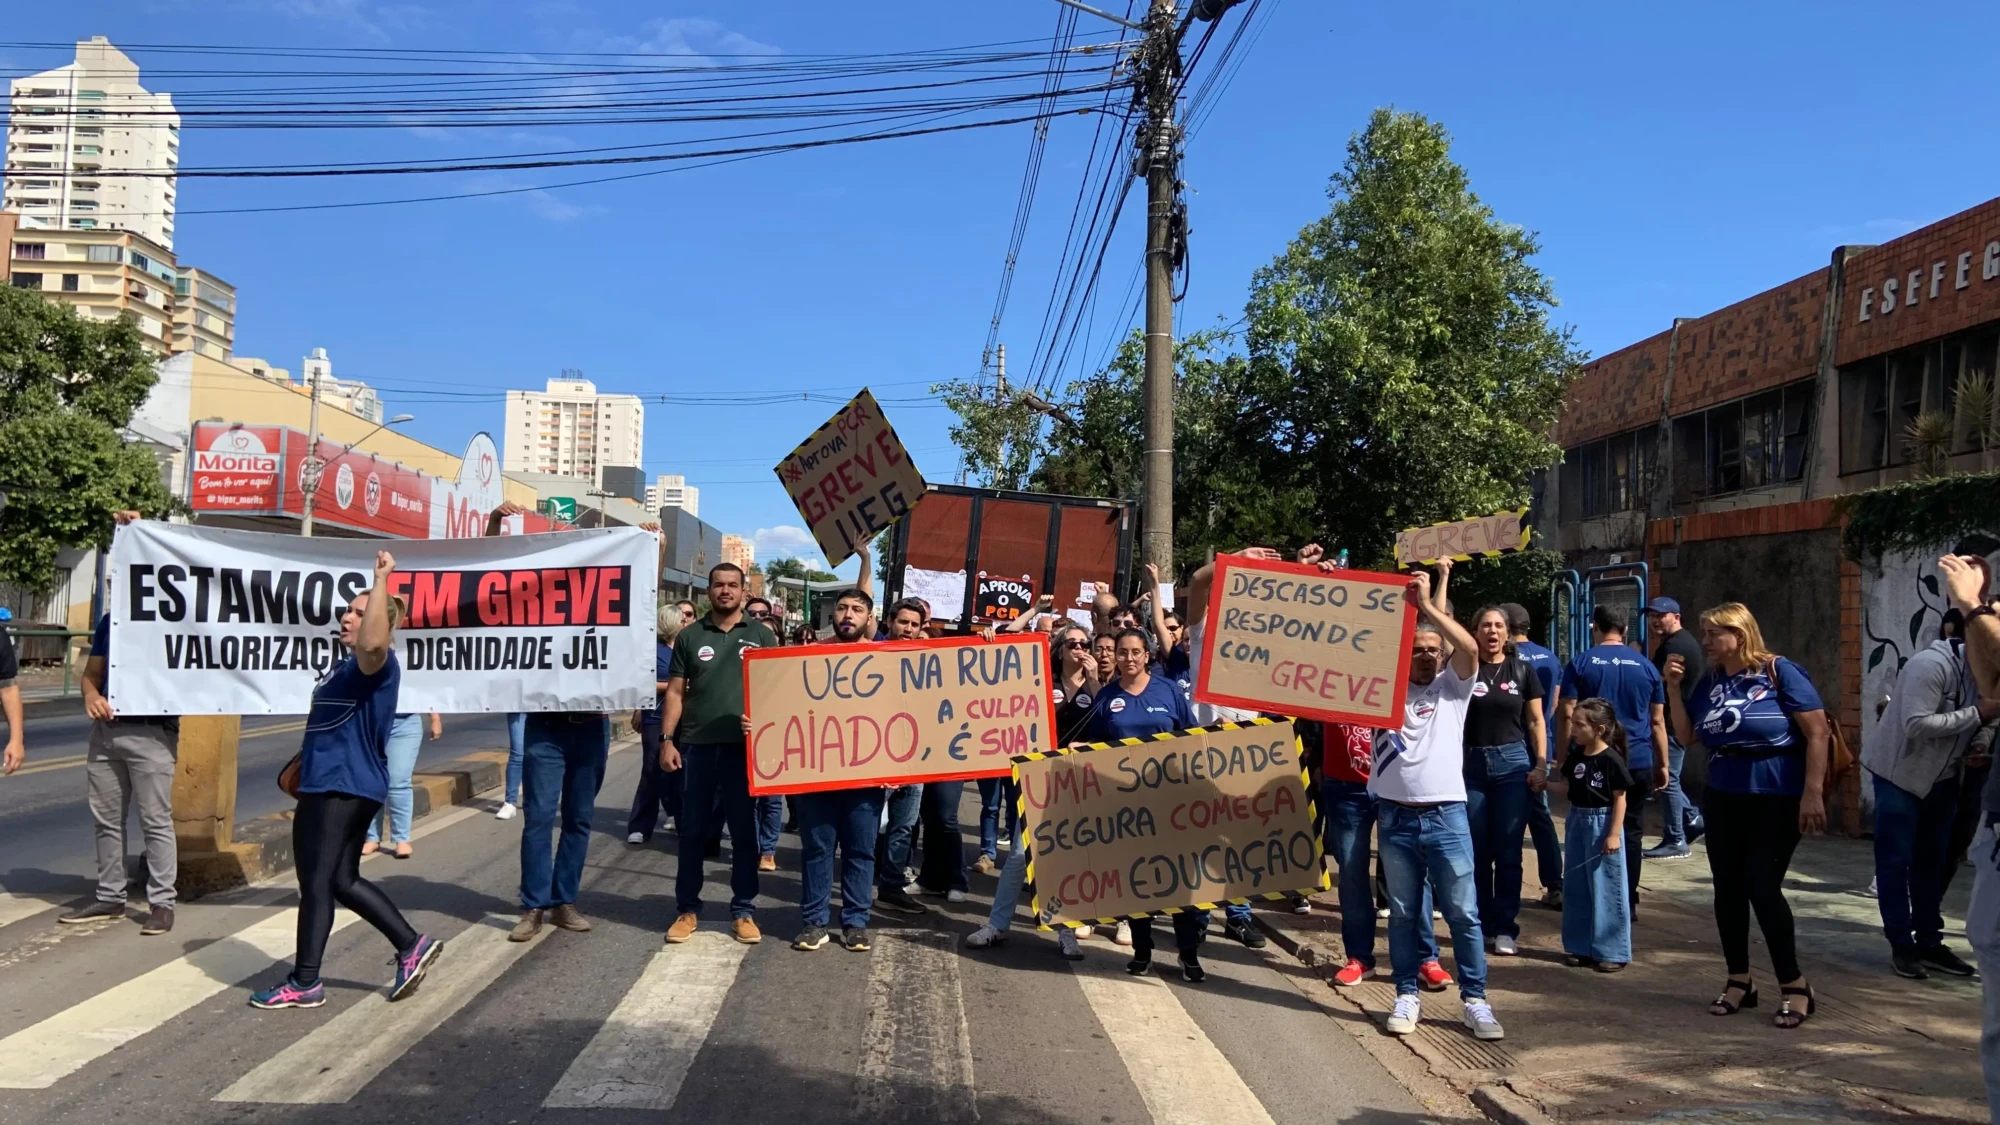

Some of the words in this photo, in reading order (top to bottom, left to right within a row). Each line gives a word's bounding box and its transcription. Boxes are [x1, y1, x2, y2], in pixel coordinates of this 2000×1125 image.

[1859, 241, 2000, 322] ESEFEG
[836, 402, 872, 441] PCR
[199, 453, 276, 471] Morita
[798, 428, 902, 526] GREVE
[835, 481, 909, 551] UEG
[1410, 518, 1521, 560] GREVE
[476, 566, 623, 626] GREVE
[979, 580, 1033, 604] APROVA
[985, 605, 1020, 619] PCR
[998, 595, 1009, 605] O
[1229, 572, 1348, 608] DESCASO
[1359, 587, 1399, 613] SE
[407, 634, 553, 671] DIGNIDADE
[562, 628, 608, 670] JÁ!
[1223, 607, 1374, 653] RESPONDE
[803, 654, 885, 701] UEG
[900, 652, 943, 694] NA
[1219, 640, 1270, 666] COM
[1271, 659, 1389, 708] GREVE
[937, 699, 954, 725] A
[966, 693, 1040, 720] CULPA
[1702, 720, 1722, 730] ANOS
[948, 721, 972, 761] É
[979, 722, 1039, 756] SUA!
[1024, 761, 1103, 810] UMA
[1116, 740, 1290, 793] SOCIEDADE
[1034, 806, 1157, 857] SEGURA
[1170, 785, 1297, 831] COMEÇA
[1058, 868, 1123, 906] COM
[1129, 828, 1316, 899] EDUCAÇÃO
